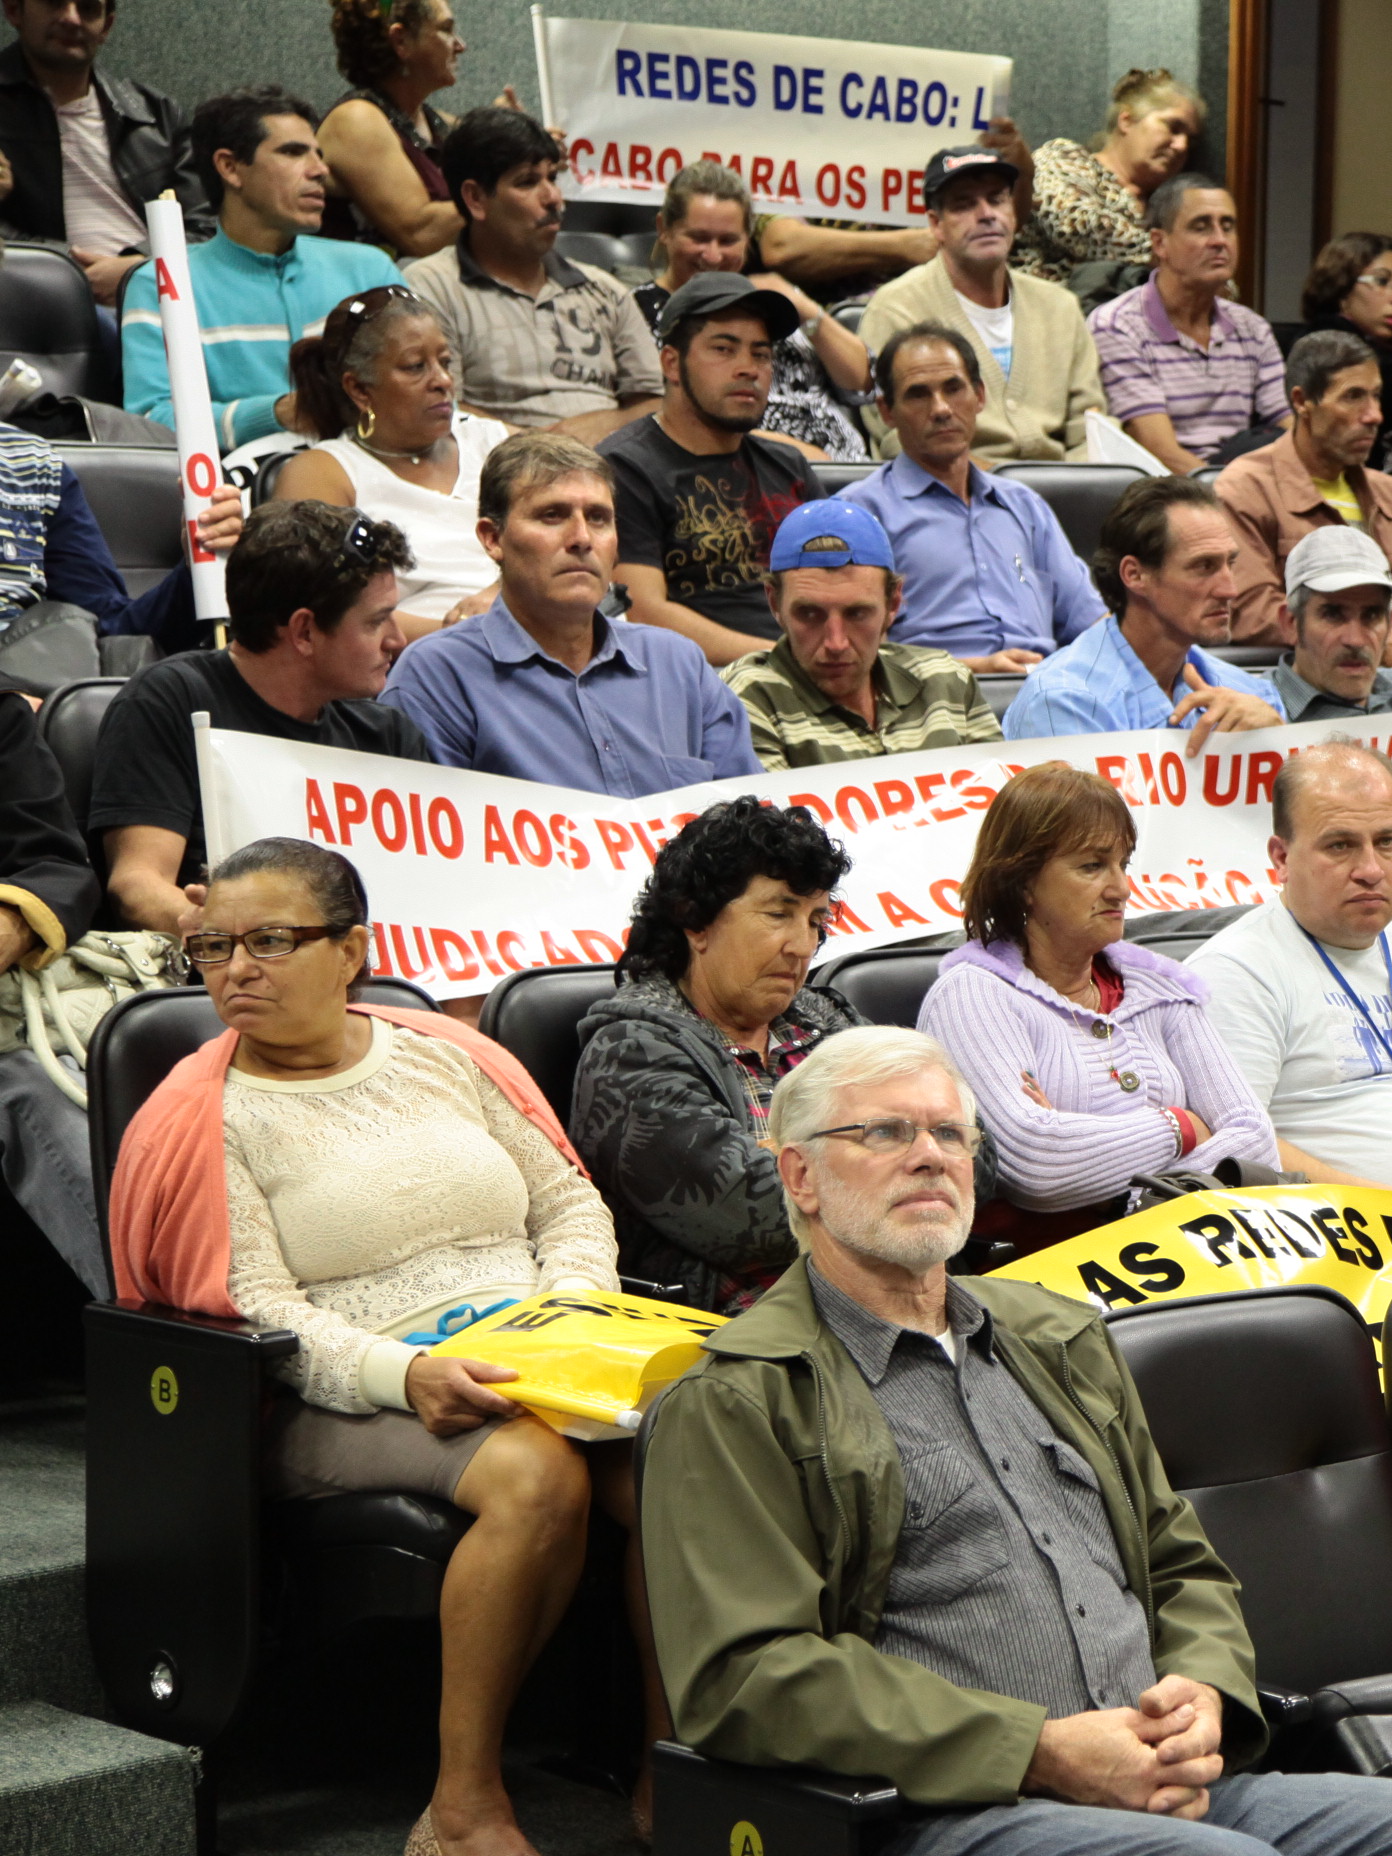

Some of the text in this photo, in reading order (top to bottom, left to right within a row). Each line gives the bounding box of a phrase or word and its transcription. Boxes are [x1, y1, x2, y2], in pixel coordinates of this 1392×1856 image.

[615, 49, 757, 107] REDES
[773, 65, 825, 115] DE
[839, 72, 961, 128] CABO:
[569, 138, 683, 191] CABO
[815, 163, 867, 210] OS
[306, 777, 465, 860] APOIO
[484, 804, 592, 871] AOS
[1095, 751, 1187, 807] RIO
[1178, 1206, 1384, 1270] REDES
[159, 1377, 171, 1402] B
